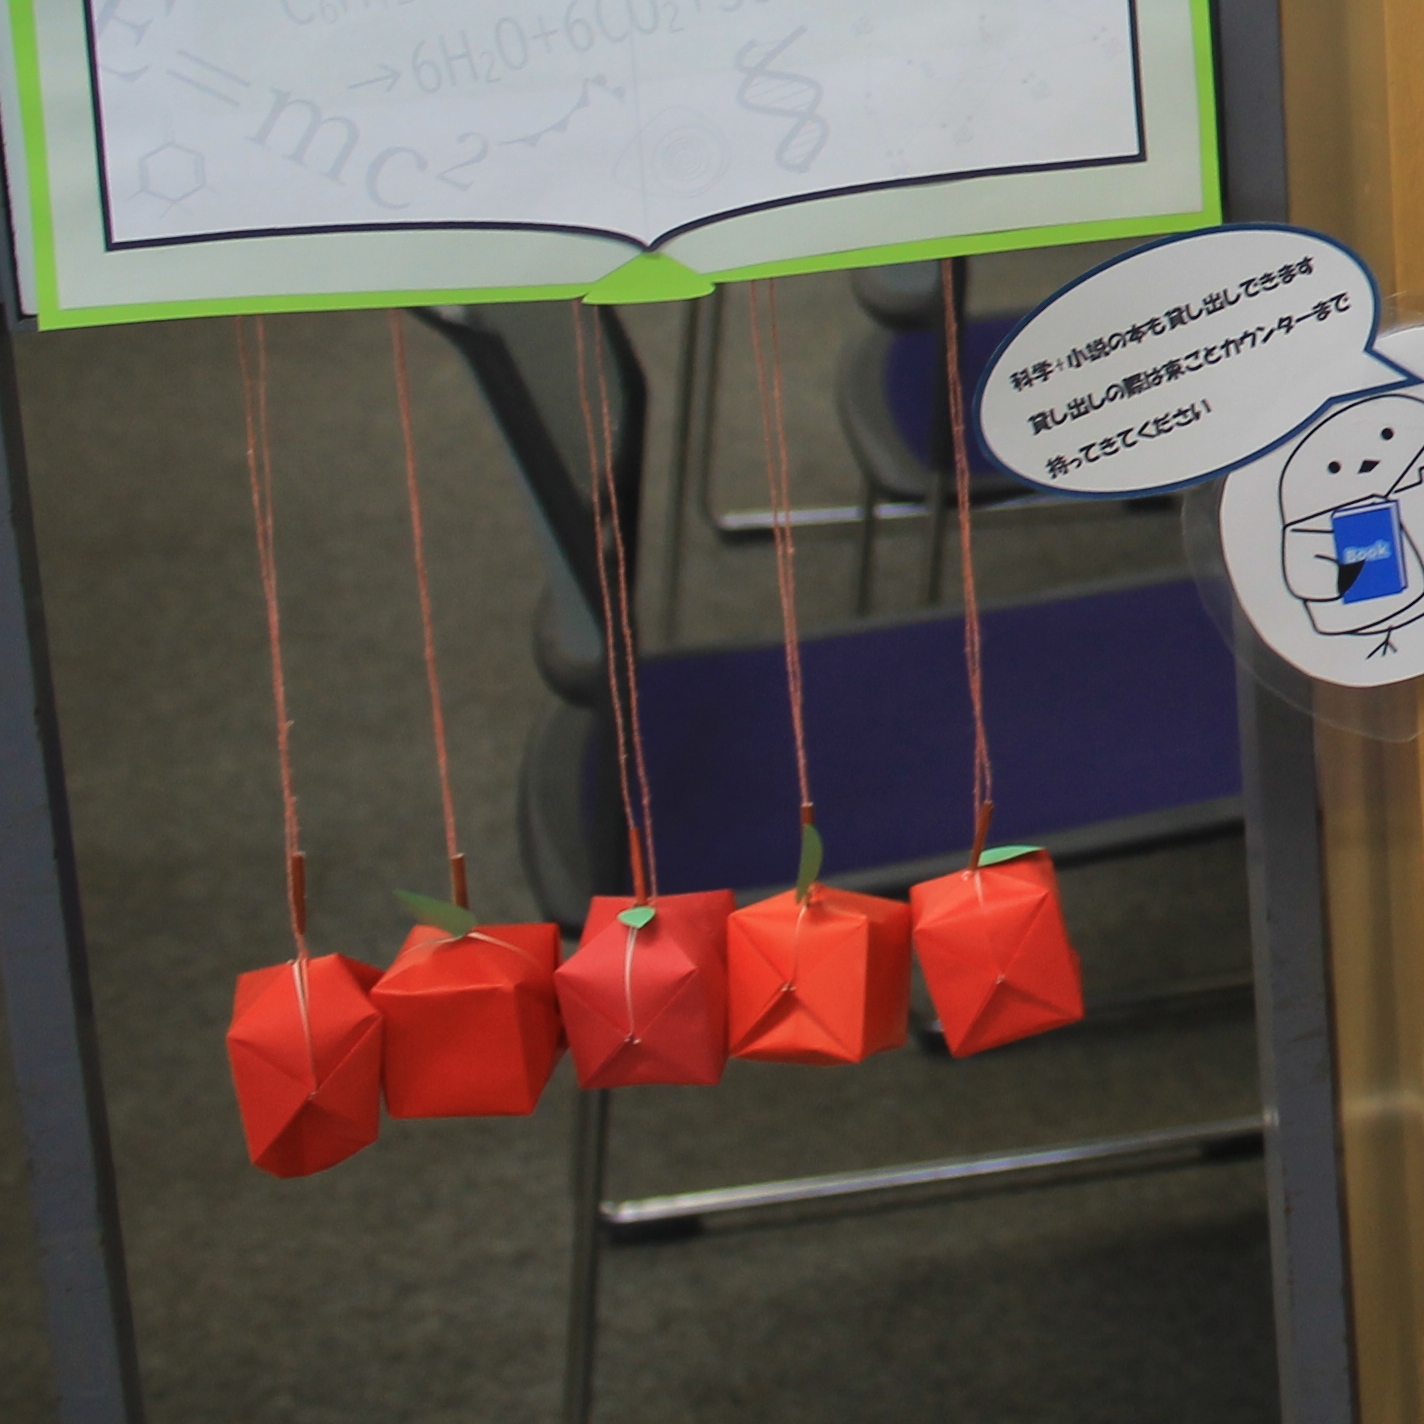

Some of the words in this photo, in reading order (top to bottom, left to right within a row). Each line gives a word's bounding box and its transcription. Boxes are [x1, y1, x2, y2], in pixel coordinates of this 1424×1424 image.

[1046, 398, 1212, 479] 持ってきてください
